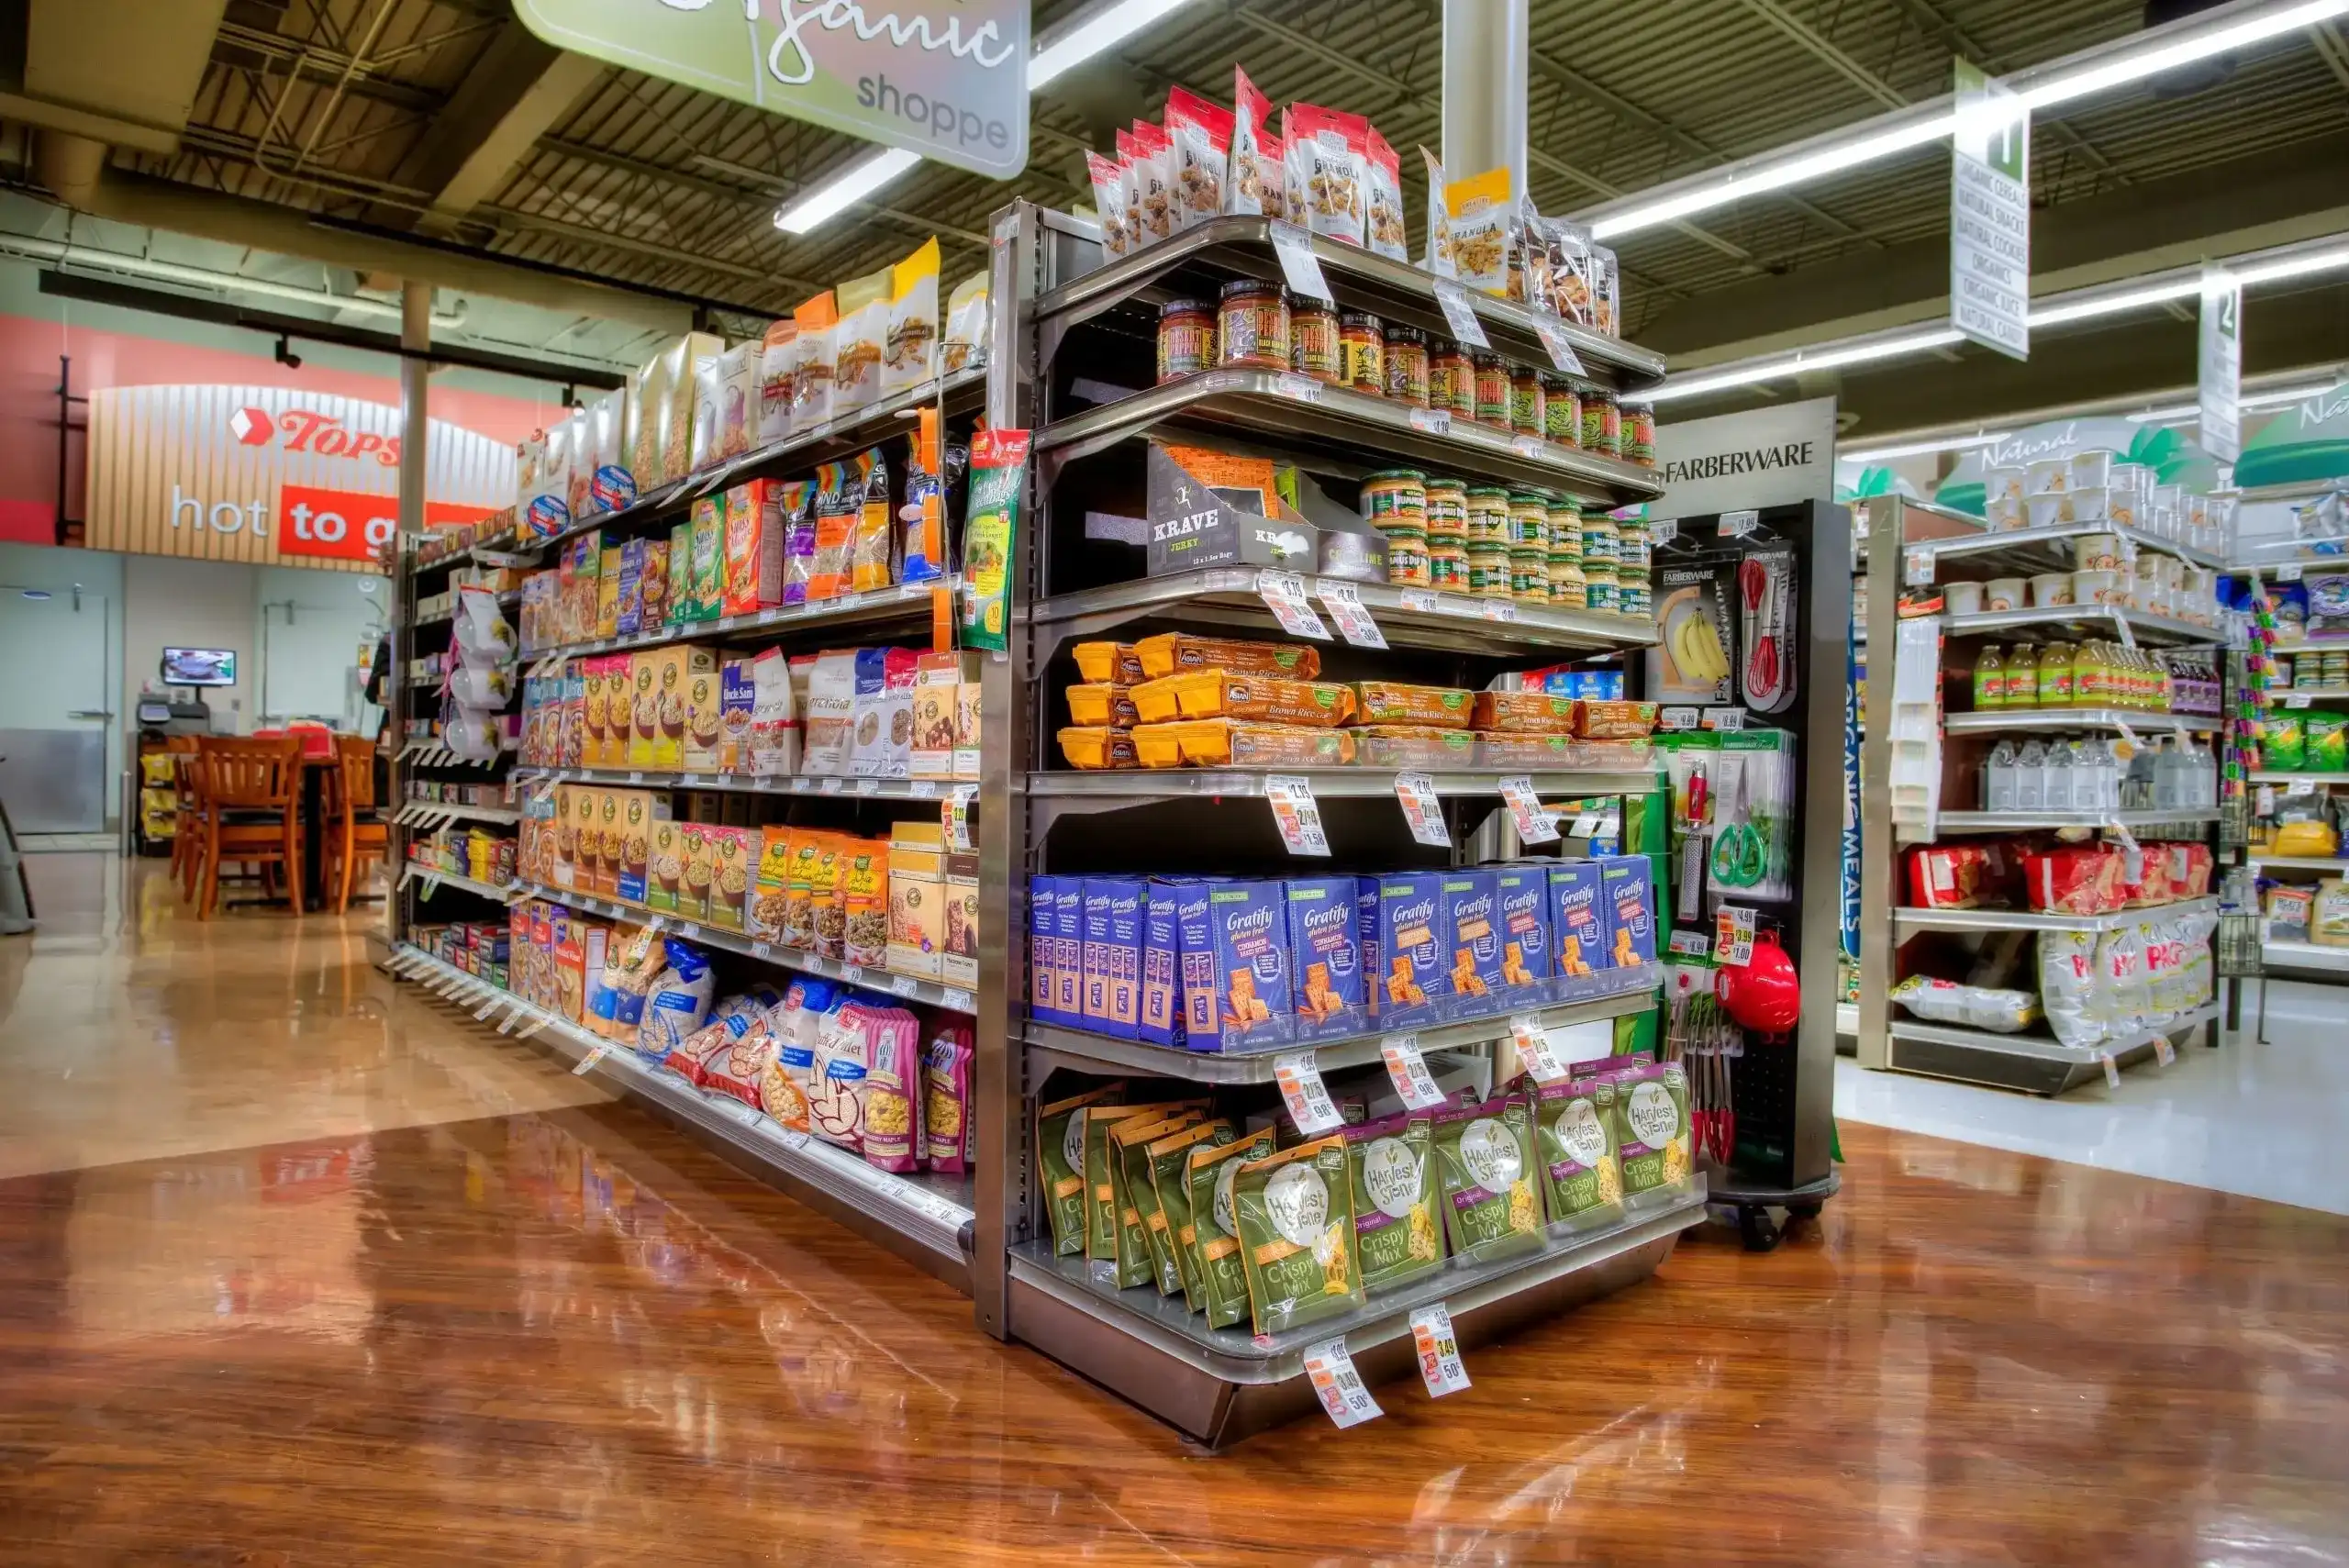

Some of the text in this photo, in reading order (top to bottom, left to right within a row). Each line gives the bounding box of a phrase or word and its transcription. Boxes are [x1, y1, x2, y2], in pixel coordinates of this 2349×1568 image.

[656, 0, 1015, 84] ganic
[856, 72, 1010, 149] shoppe
[1958, 188, 1995, 221] NATURAL
[279, 410, 401, 467] Tops
[1981, 422, 2080, 472] Natural
[1665, 442, 1813, 484] FARBERWARE
[171, 484, 269, 537] hot
[290, 502, 347, 542] to
[1153, 508, 1219, 542] KRAVE
[1170, 538, 1198, 552] JERKY
[1663, 570, 1714, 582] FARBERWARE
[991, 606, 999, 619] 10
[739, 688, 753, 698] Sam
[1229, 691, 1249, 701] ASIAN
[1269, 706, 1297, 717] Brown
[1297, 707, 1316, 717] Rice
[1406, 709, 1429, 719] Brown
[1430, 710, 1444, 720] Rice
[1287, 784, 1310, 799] $2.79
[1303, 833, 1325, 846] $1.58
[1429, 826, 1446, 838] $1.58
[1843, 826, 1862, 933] MEALS
[1032, 890, 1054, 903] Gratify
[1561, 884, 1595, 906] Gratify
[1614, 878, 1644, 901] Gratify
[1056, 892, 1080, 906] Gratify
[1085, 895, 1110, 908] Gratify
[1111, 895, 1137, 910] Gratify
[1149, 898, 1175, 913] Gratify
[1179, 898, 1208, 916] Gratify
[1453, 893, 1493, 918] Gratify
[1503, 888, 1540, 912] Gratify
[1227, 905, 1274, 931] Gratify
[1304, 902, 1350, 928] Gratify
[1393, 897, 1435, 924] Gratify
[1737, 910, 1753, 923] $4.99
[1230, 927, 1265, 943] gluten free
[1314, 933, 1343, 947] CINNAMON
[1735, 930, 1753, 943] $3.99
[1237, 938, 1267, 952] CINNAMON
[1733, 947, 1750, 961] $1.00
[1542, 1057, 1556, 1071] 98¢
[1418, 1081, 1434, 1096] 98¢
[1314, 1104, 1331, 1119] 98¢
[1641, 1119, 1675, 1139] Stone
[1320, 1151, 1341, 1160] GLUTEN
[1553, 1163, 1575, 1176] Original
[1624, 1158, 1660, 1178] Crispy
[1559, 1175, 1595, 1196] Crispy
[1635, 1172, 1657, 1188] Mix
[1456, 1190, 1482, 1205] Original
[1570, 1194, 1593, 1209] Mix
[1463, 1203, 1505, 1227] Crispy
[1476, 1219, 1504, 1239] Mix
[1360, 1228, 1405, 1254] Crispy
[1375, 1245, 1401, 1267] Mix
[1267, 1257, 1315, 1284] Crispy
[1284, 1278, 1311, 1298] Mix
[1443, 1362, 1460, 1379] 50¢
[1349, 1394, 1368, 1410] 50¢
